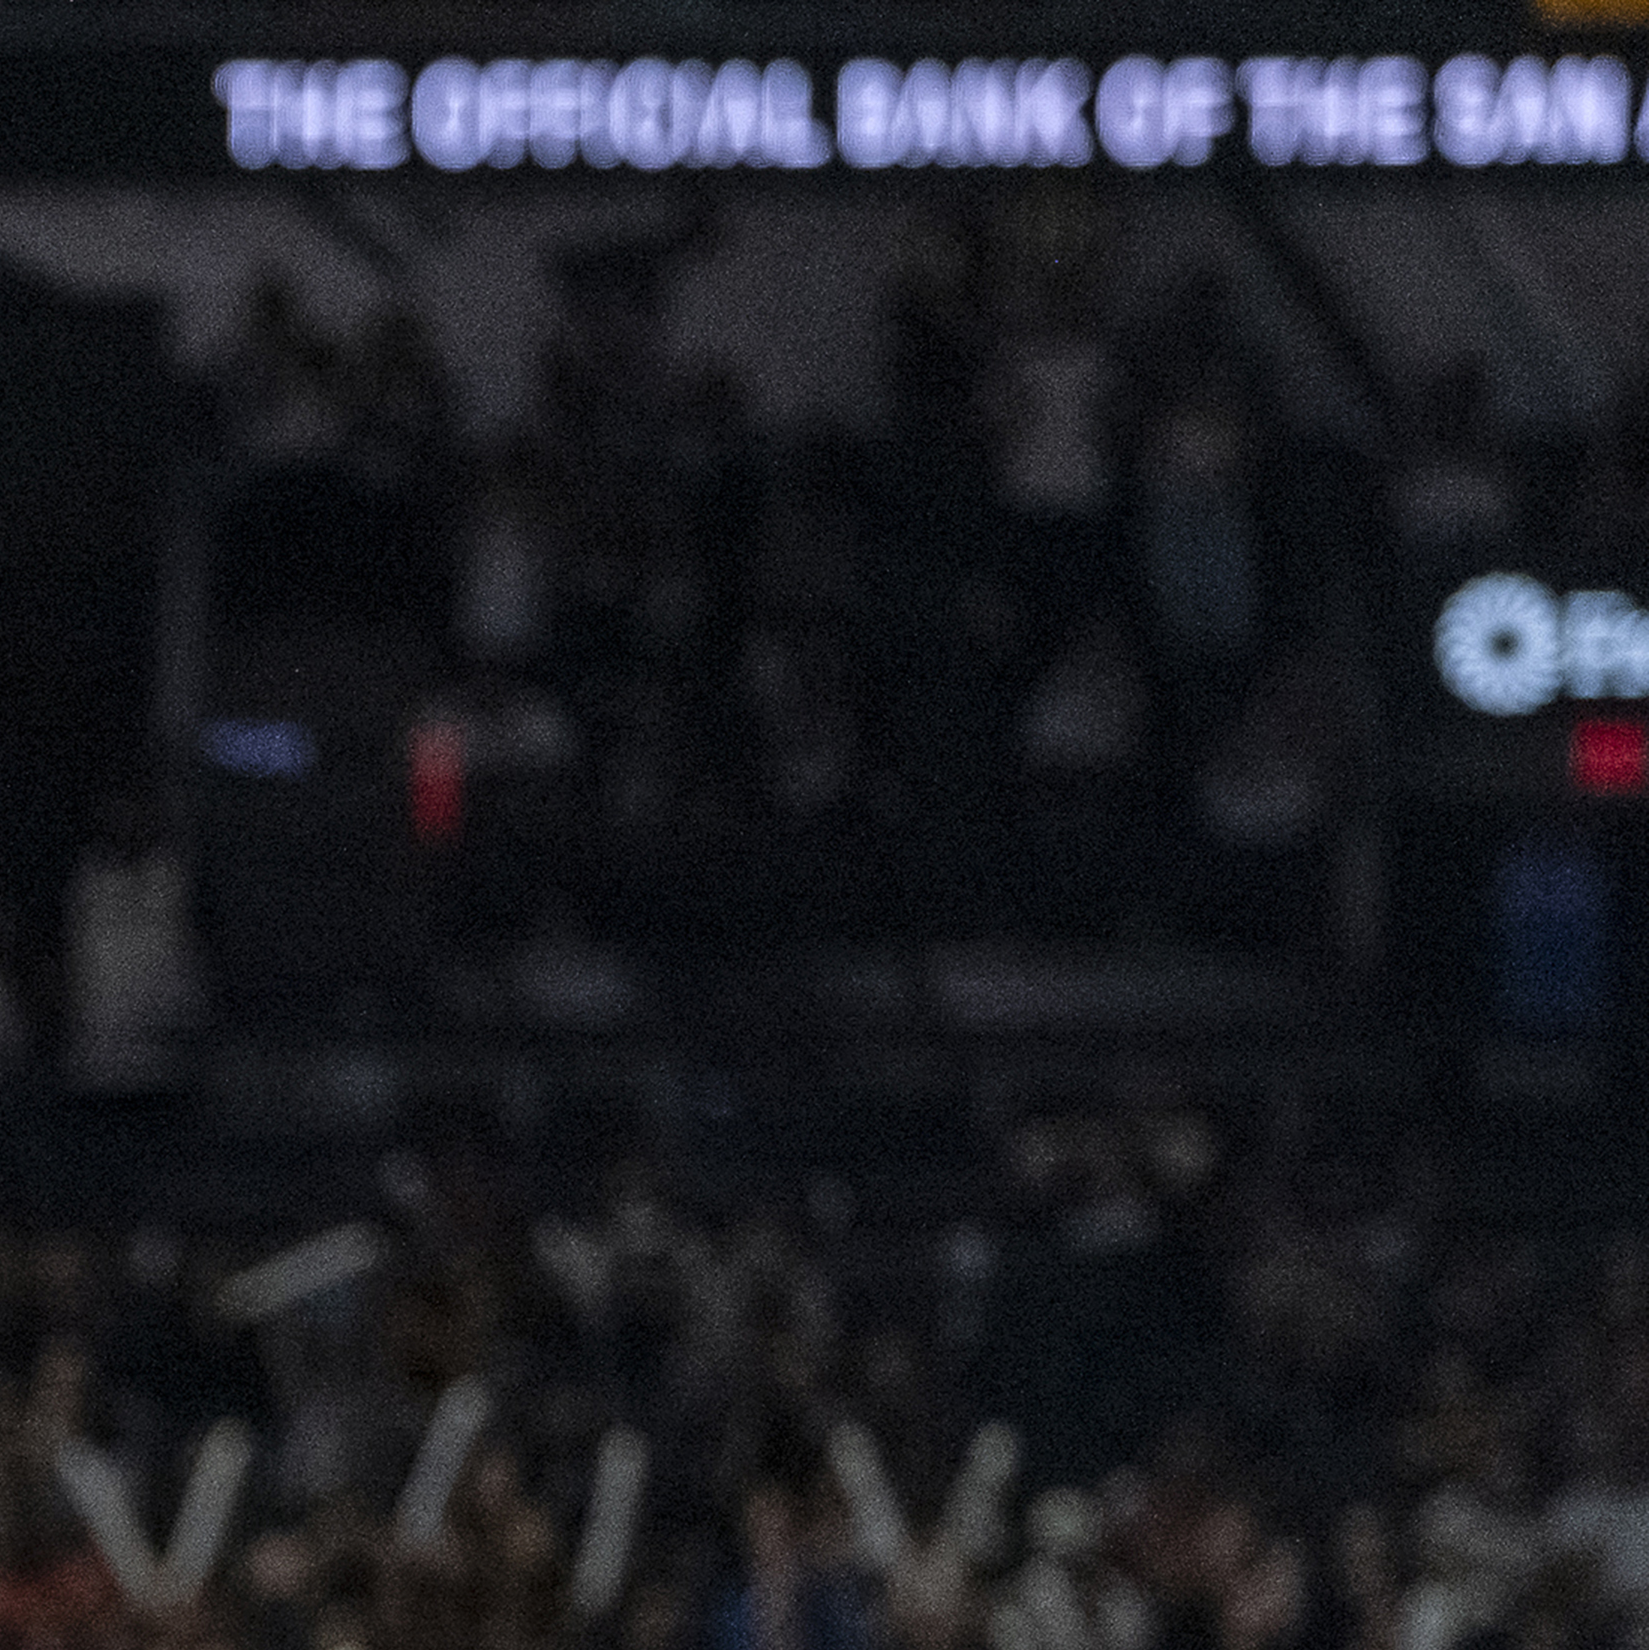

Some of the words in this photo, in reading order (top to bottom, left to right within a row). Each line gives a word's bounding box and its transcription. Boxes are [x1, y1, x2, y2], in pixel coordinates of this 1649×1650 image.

[212, 58, 409, 170] THE
[411, 55, 832, 171] OFFICIAL
[836, 57, 1094, 168] BANK
[1098, 54, 1233, 169] OF
[1235, 55, 1429, 167] THE
[1433, 54, 1631, 167] SAN
